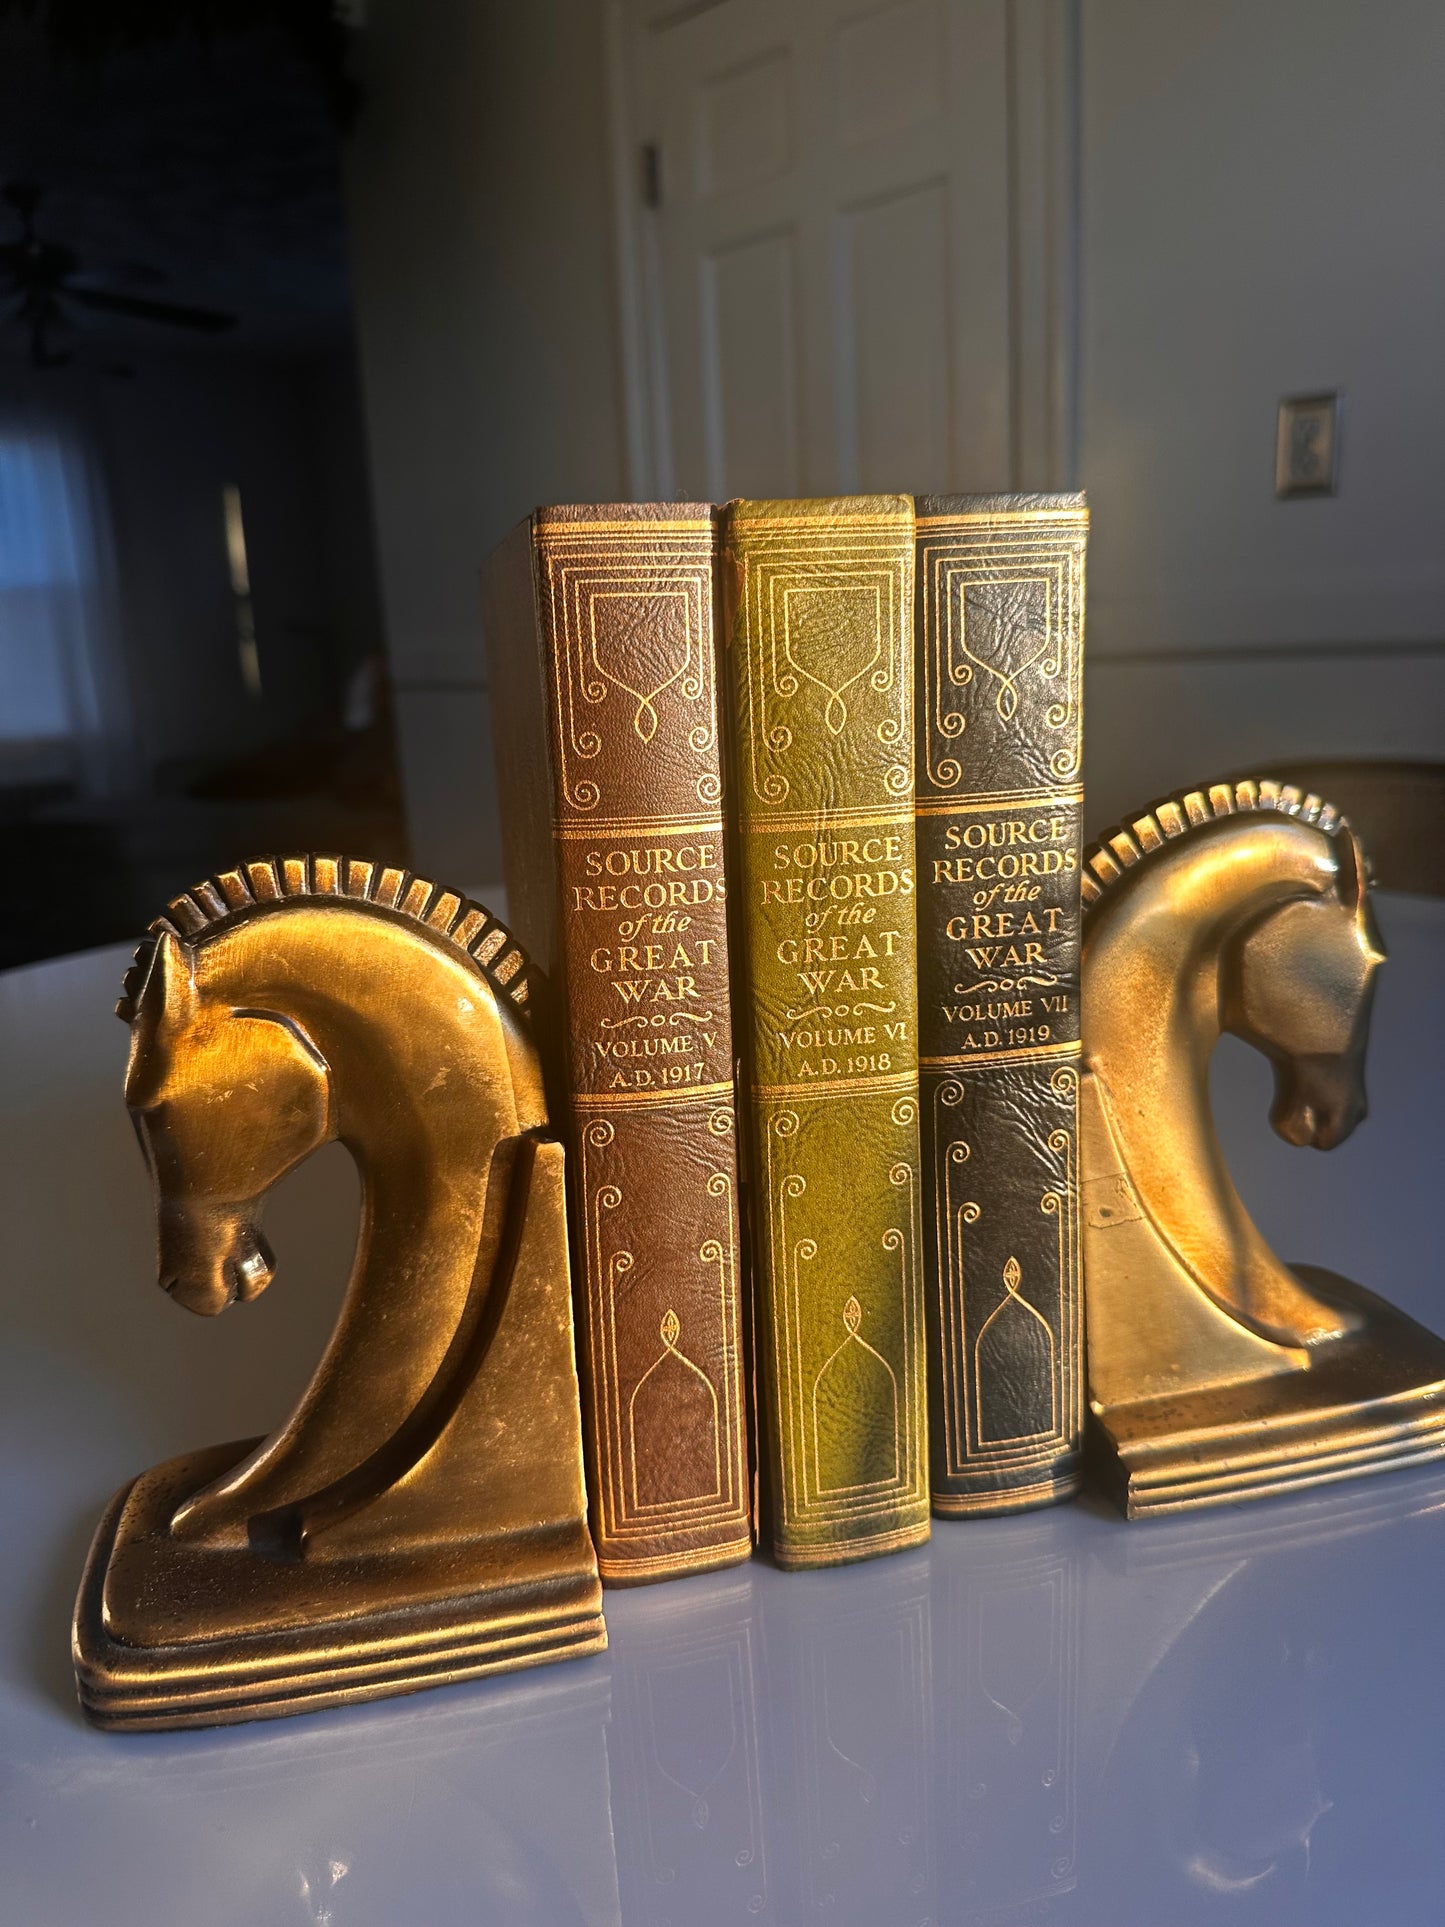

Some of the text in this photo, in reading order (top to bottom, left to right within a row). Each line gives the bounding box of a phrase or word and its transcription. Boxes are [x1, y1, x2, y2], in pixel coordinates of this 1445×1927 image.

[945, 817, 1068, 850] SOURCE
[586, 844, 717, 876] SOURCE
[774, 836, 903, 870] SOURCE
[932, 848, 1077, 884] RECORDS
[572, 877, 728, 911] RECORDS
[761, 869, 915, 905] RECORDS
[973, 880, 1042, 912] of the
[618, 911, 692, 942] of the
[805, 903, 877, 934] of the
[946, 907, 1064, 942] GREAT
[590, 940, 716, 973] GREAT
[777, 930, 901, 965] GREAT
[964, 942, 1048, 970] WAR
[611, 976, 701, 1004] WAR
[797, 967, 885, 995] WAR
[942, 995, 1068, 1023] VOLUME VII
[594, 1031, 718, 1058] VOLUME V
[778, 1022, 908, 1049] VOLUME VI
[961, 1025, 1050, 1050] A.D. 1919
[609, 1063, 705, 1088] A.D. 1917
[797, 1053, 892, 1077] A.D. 1918
